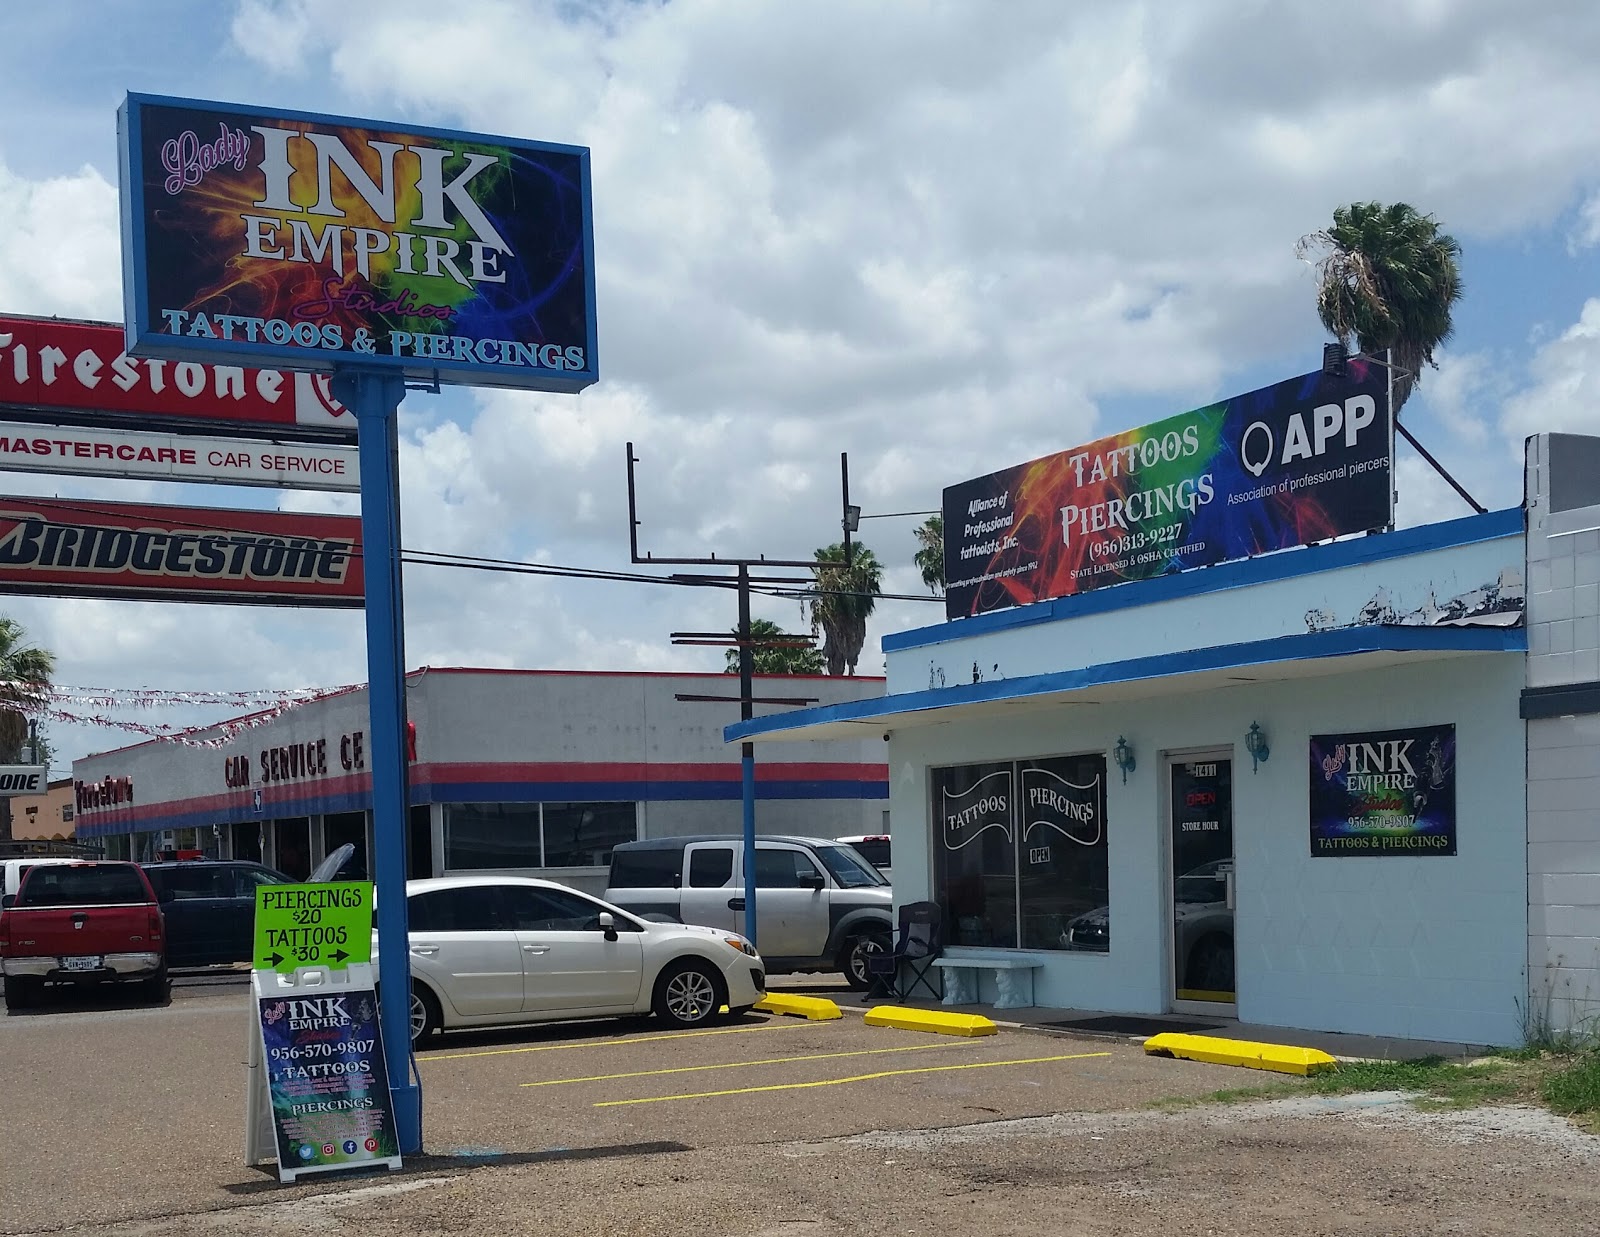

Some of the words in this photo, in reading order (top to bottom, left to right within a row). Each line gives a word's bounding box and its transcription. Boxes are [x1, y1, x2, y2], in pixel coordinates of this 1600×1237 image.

[161, 121, 250, 196] Lady
[250, 125, 516, 258] INK
[240, 214, 507, 291] EMPIRE
[291, 276, 457, 320] Studios
[161, 308, 344, 350] TATTOOS
[351, 327, 377, 355] &
[389, 330, 586, 371] PIERCINGS
[0, 332, 285, 404] irestone
[1281, 394, 1376, 466] APP
[207, 451, 251, 469] CAR
[260, 454, 346, 475] SERVICE
[1069, 424, 1199, 488] TATTOOS
[1227, 483, 1276, 505] Association
[1278, 474, 1289, 493] of
[1290, 464, 1346, 493] professional
[1349, 456, 1389, 478] piercers
[967, 498, 998, 518] Alliance
[998, 491, 1009, 510] of
[1059, 473, 1215, 549] PIERCINGS
[963, 512, 1014, 538] Professional
[0, 517, 350, 580] BRIDGESTONE
[1089, 522, 1183, 562] (956)313-9227
[1070, 568, 1092, 580] STATE
[1094, 559, 1129, 575] LICENSED
[1130, 555, 1136, 566] &
[1137, 550, 1162, 565] OSHA
[1164, 542, 1206, 560] CERTIFIED
[225, 755, 249, 788] CAR
[261, 738, 327, 783] SERVICE
[1347, 739, 1417, 778] INK
[1346, 774, 1414, 793] EMPIRE
[947, 795, 1006, 830] TATTOOS
[1029, 787, 1094, 826] PIERCINGS
[1186, 793, 1216, 806] OPEN
[1182, 822, 1201, 832] STORE
[1348, 815, 1414, 828] 956-570-9807
[1031, 848, 1049, 863] OPEN
[1318, 837, 1369, 849] TATTOOS
[1371, 836, 1379, 848] &
[1382, 835, 1448, 850] PIERCINGS
[262, 888, 362, 910] PIERCINGS
[292, 908, 322, 925] $20
[265, 925, 348, 948] TATTOOS
[291, 945, 320, 962] $30
[286, 997, 352, 1020] INK
[288, 1016, 351, 1031] EMPIRE
[271, 1040, 375, 1061] 956-570-9807
[282, 1059, 371, 1079] TATTOOS
[292, 1097, 374, 1117] PIERCINGS
